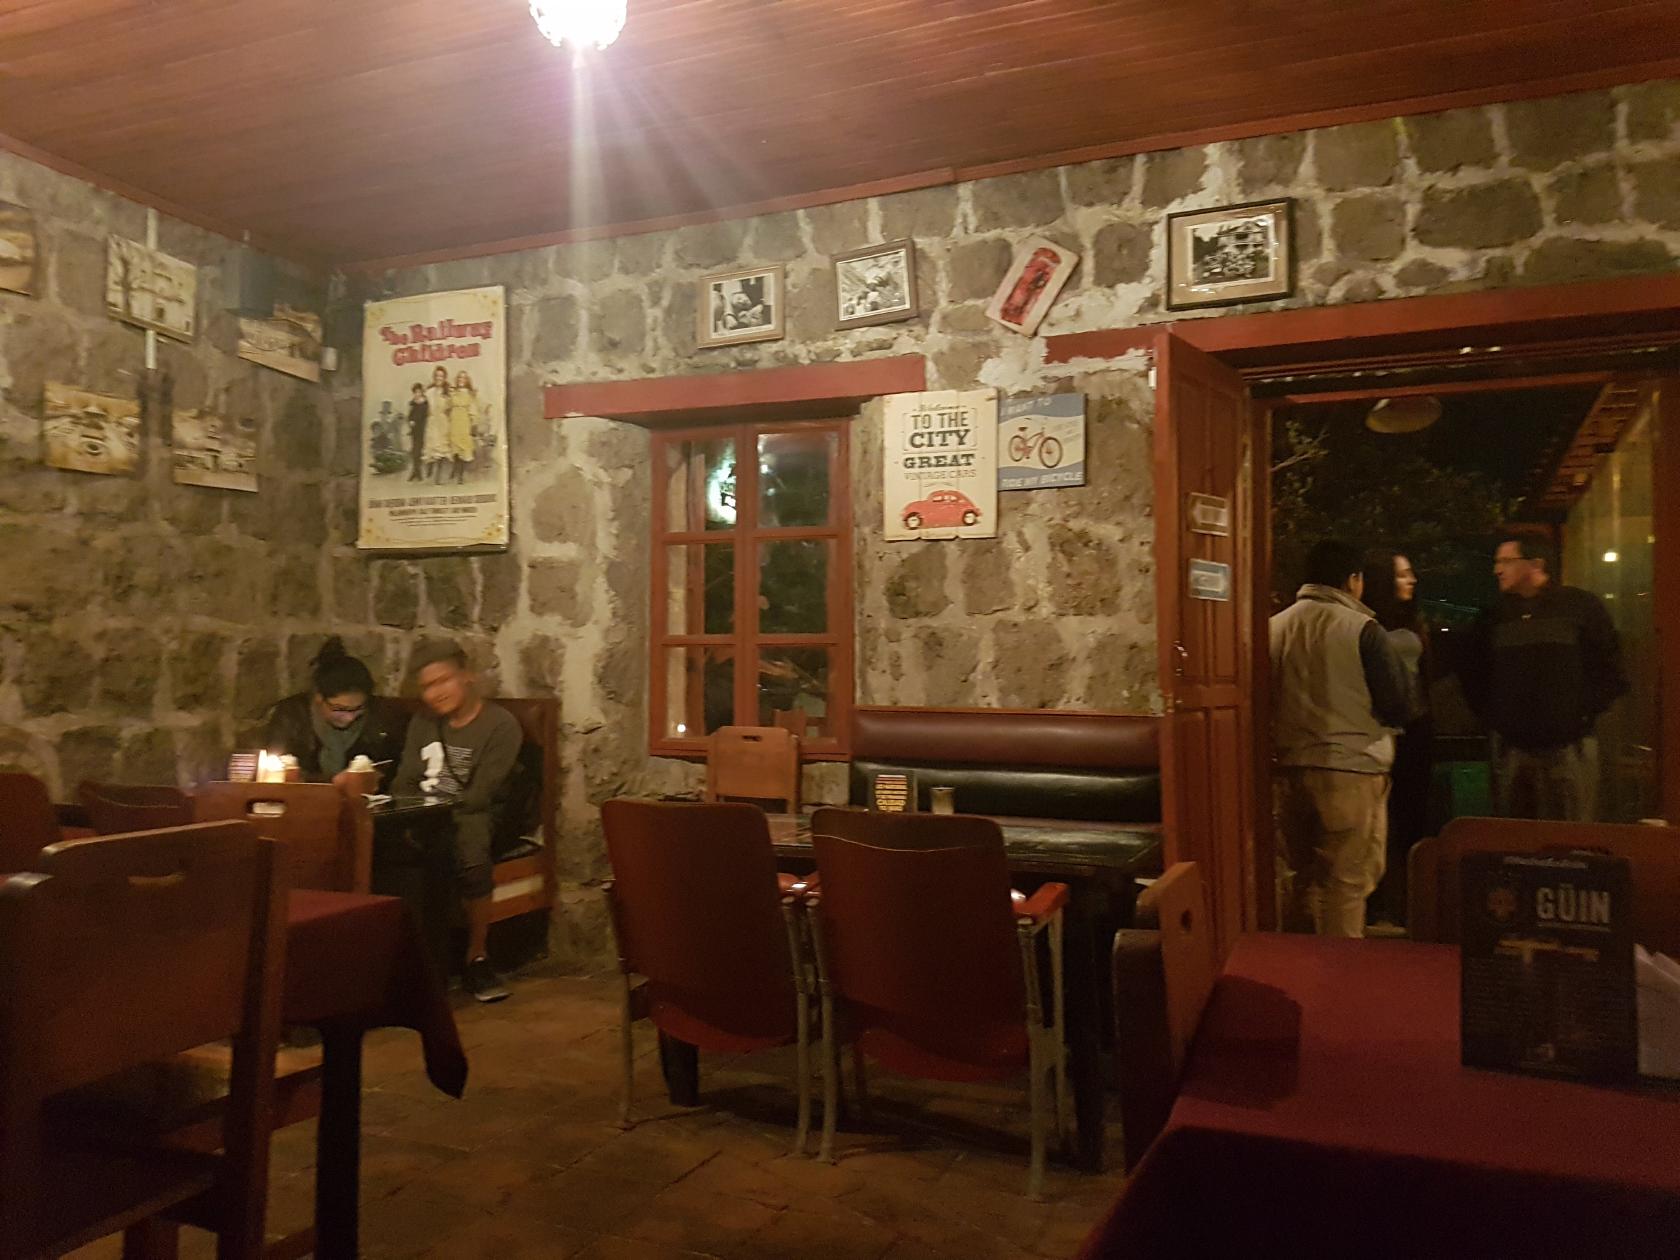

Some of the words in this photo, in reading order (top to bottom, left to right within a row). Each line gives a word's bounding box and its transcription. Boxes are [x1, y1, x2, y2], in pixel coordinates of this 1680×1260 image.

[410, 319, 493, 343] Railway
[392, 343, 481, 366] Children
[911, 414, 931, 430] TO
[937, 411, 969, 428] THE
[910, 429, 971, 449] CITY
[903, 453, 975, 469] GREAT
